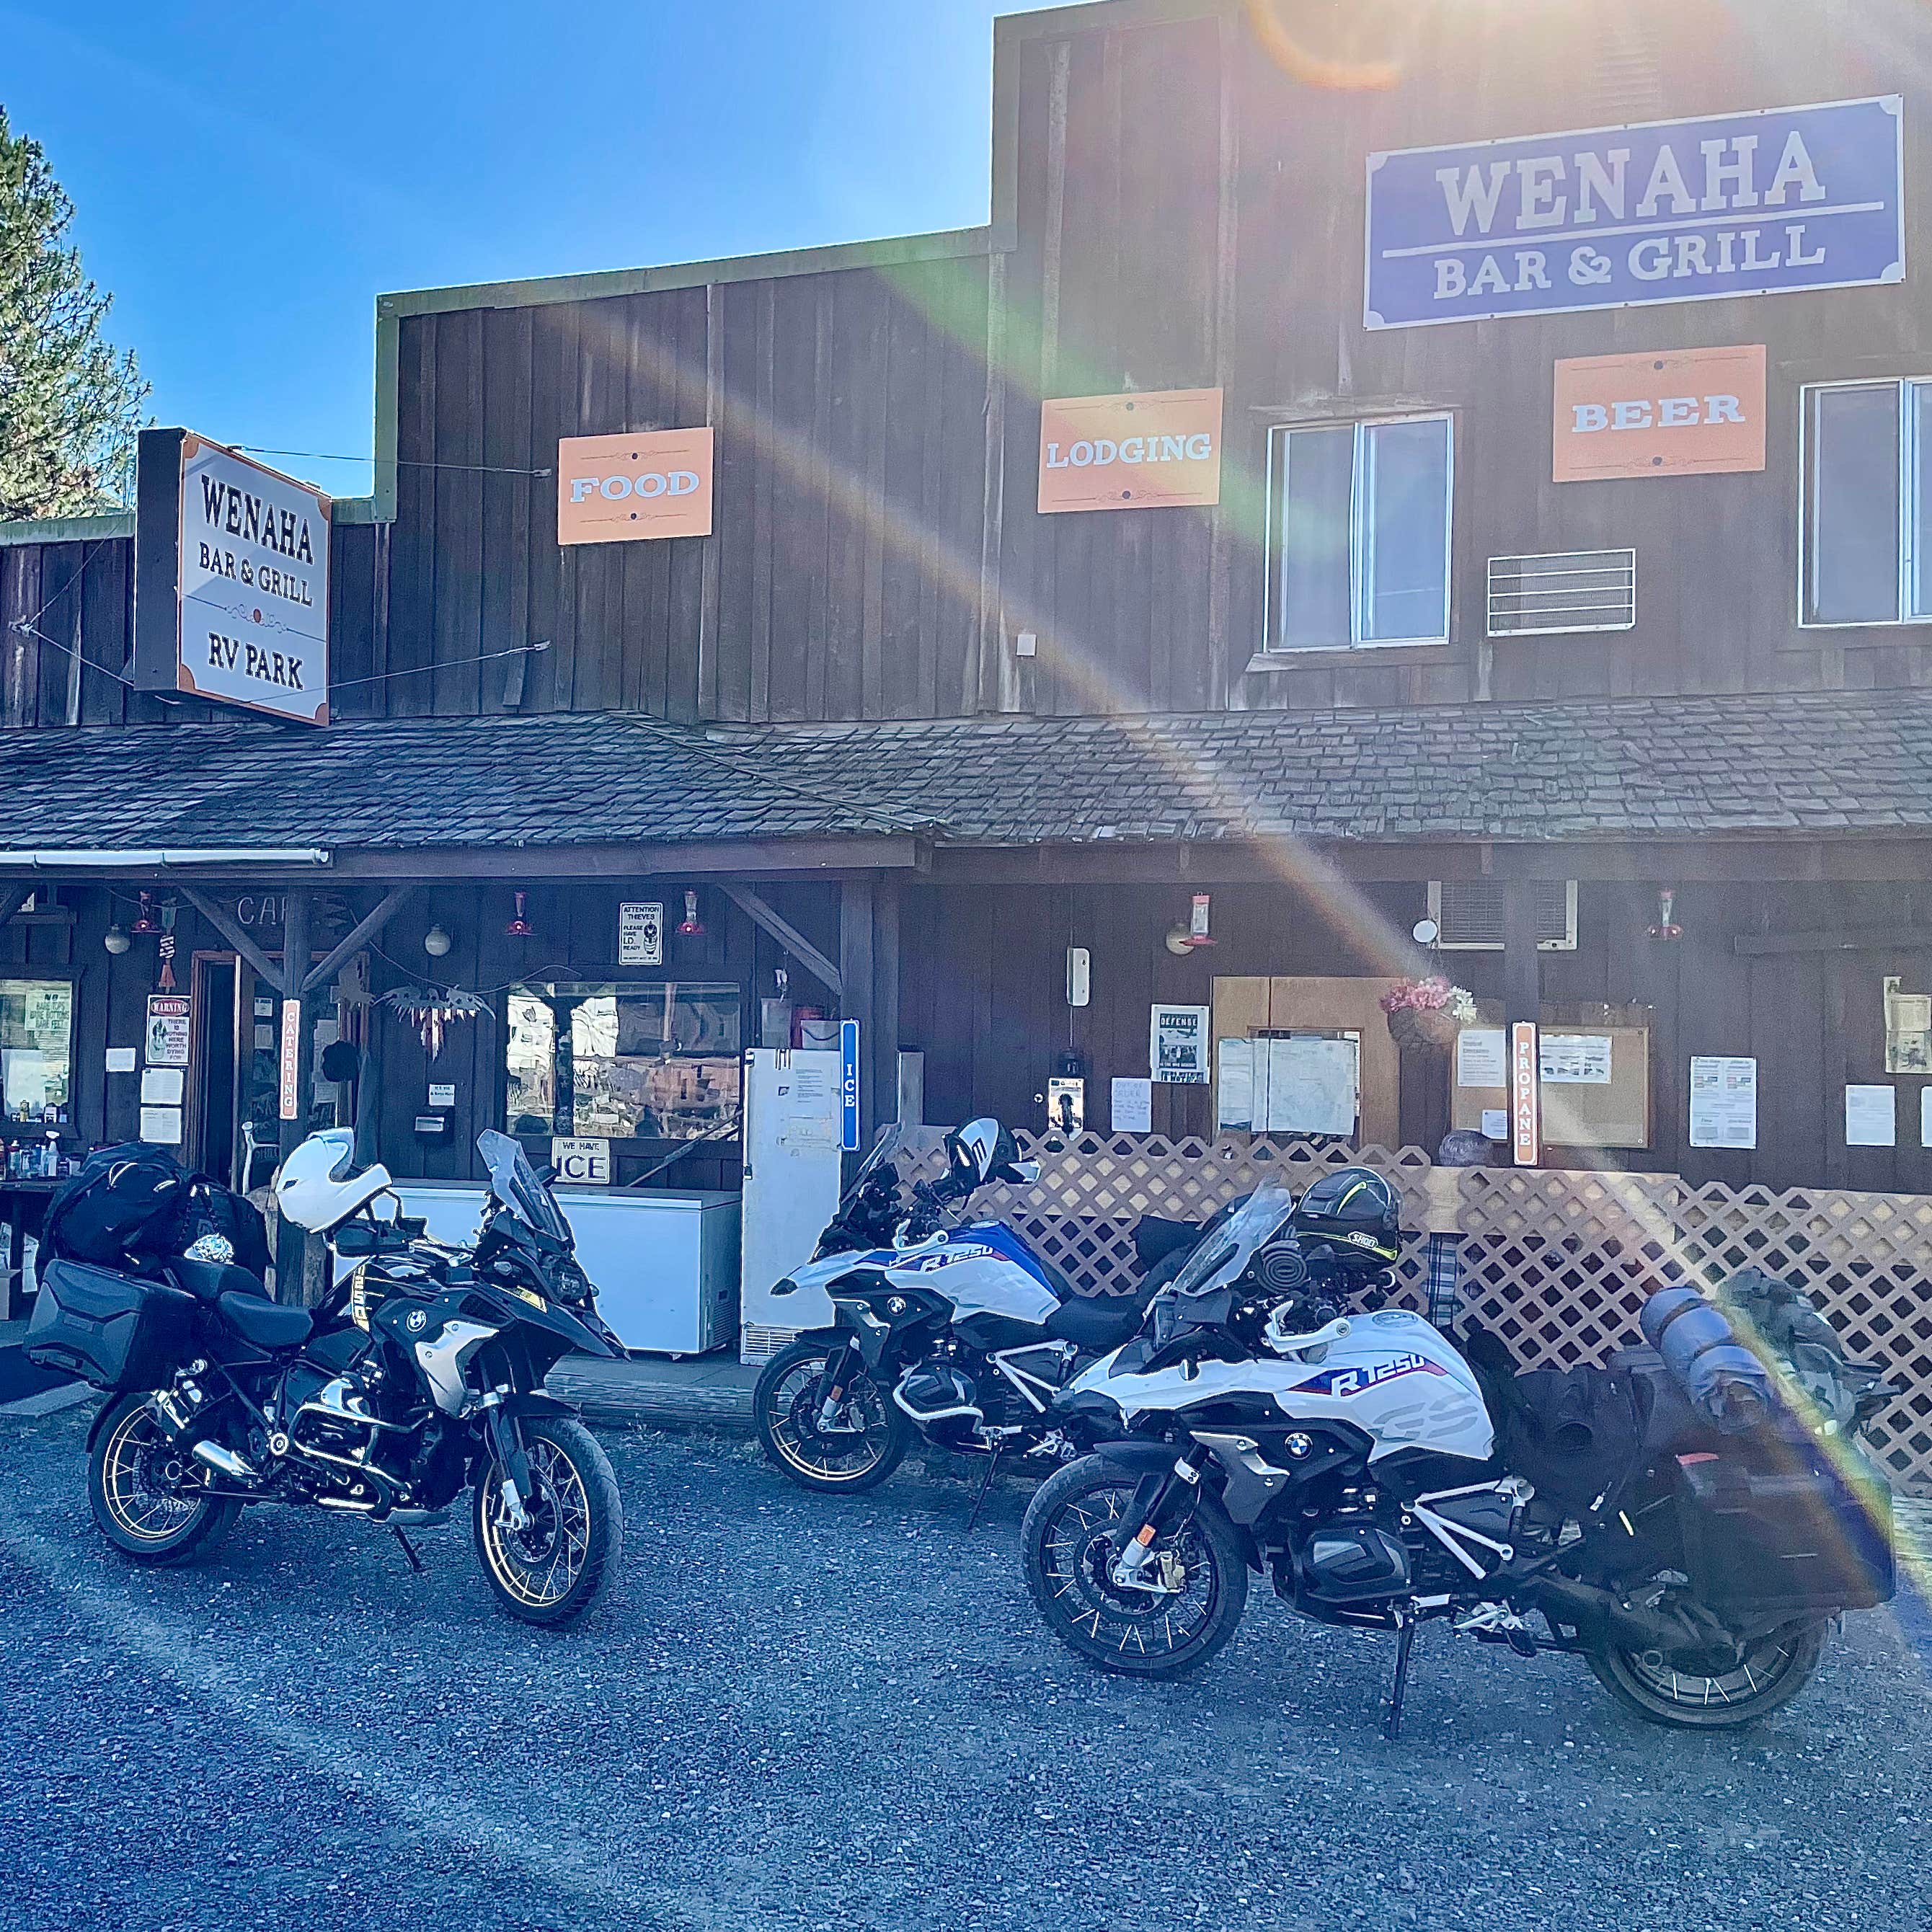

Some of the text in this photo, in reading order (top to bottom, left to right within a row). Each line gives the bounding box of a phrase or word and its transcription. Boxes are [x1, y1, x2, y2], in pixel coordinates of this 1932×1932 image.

[1435, 130, 1826, 235] WENAHA
[1433, 225, 1826, 299] BAR & GRILL
[1572, 395, 1745, 433] BEER
[1046, 433, 1212, 469] LODGING
[570, 471, 699, 503] FOOD
[201, 474, 314, 565] WENAHA
[199, 541, 312, 607] BAR & GRILL
[208, 632, 303, 691] RV PARK
[152, 1002, 187, 1012] WARNING
[283, 1012, 296, 1107] CATERING
[844, 1063, 855, 1107] ICE
[1518, 1042, 1532, 1146] PROPANE
[557, 1154, 606, 1179] ICE
